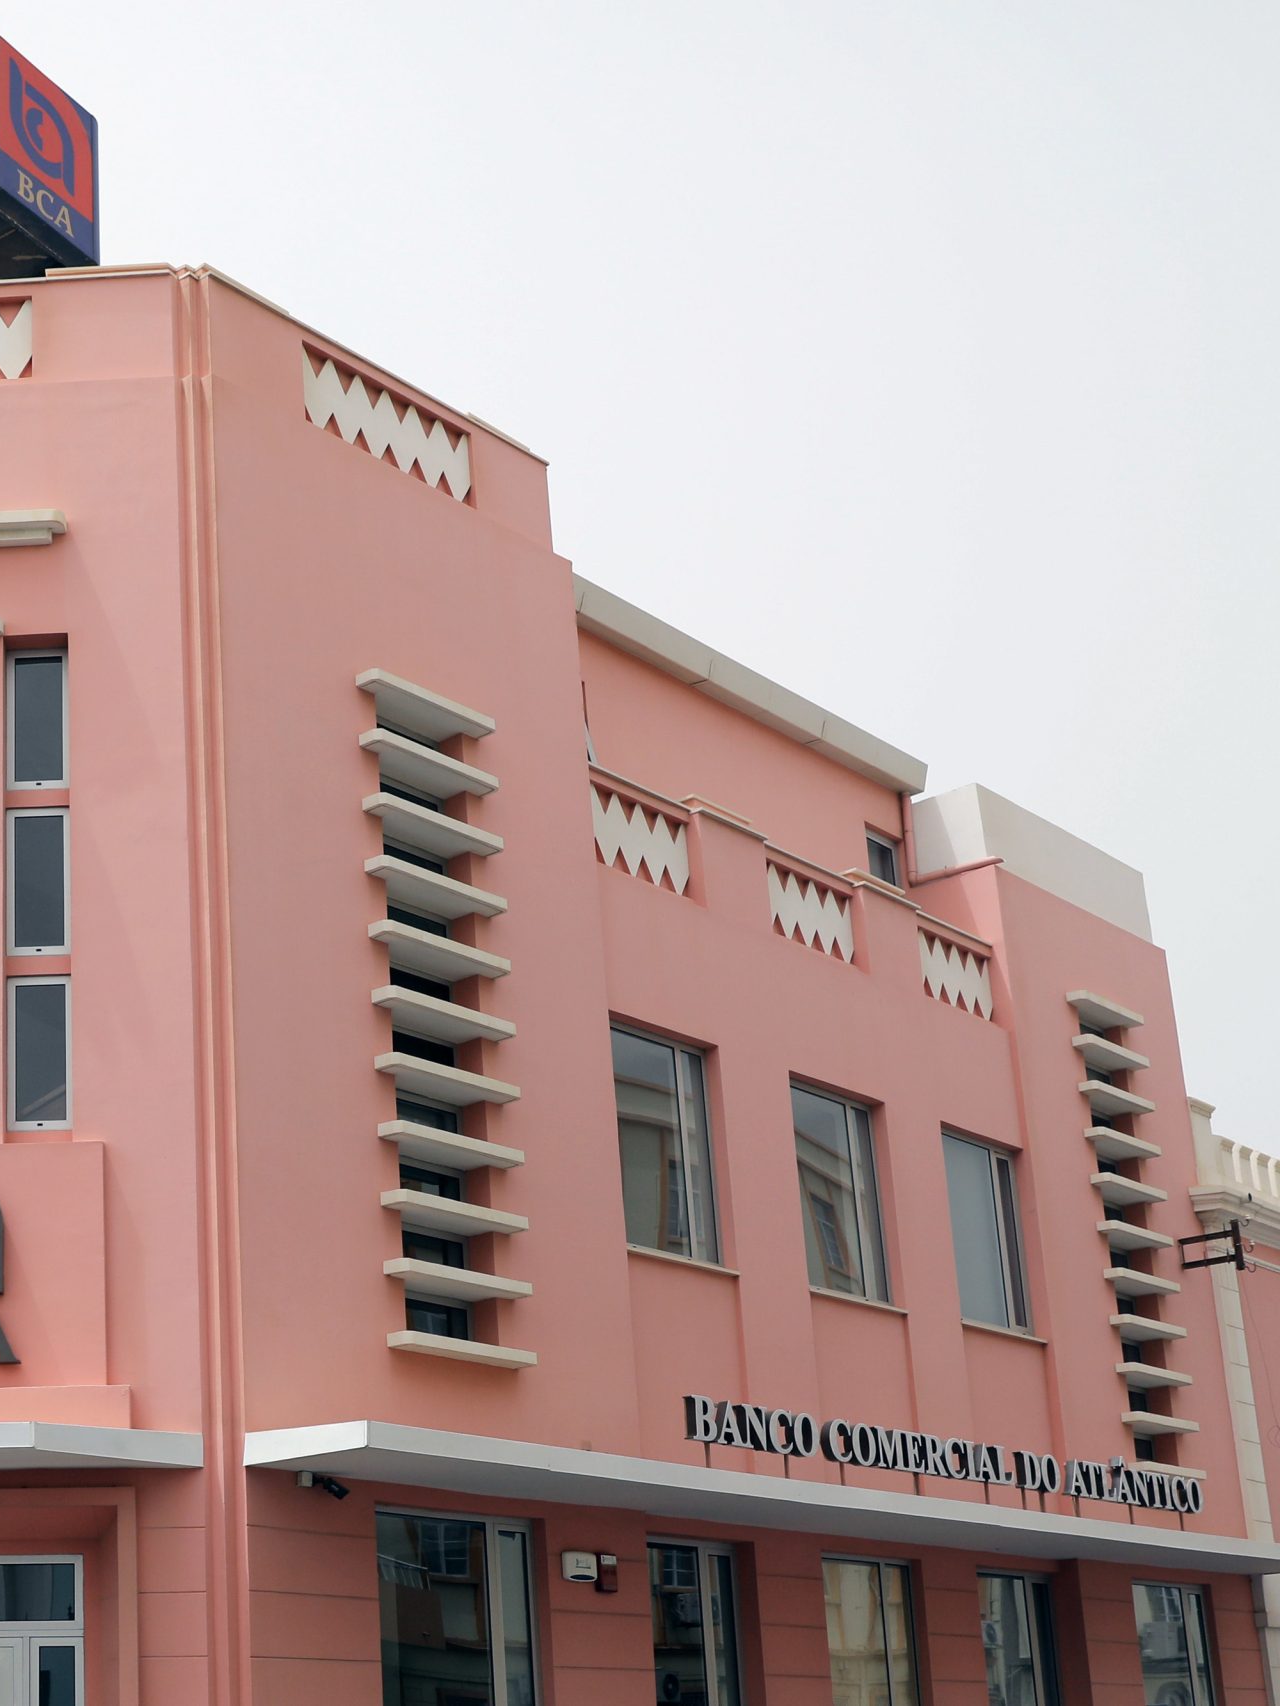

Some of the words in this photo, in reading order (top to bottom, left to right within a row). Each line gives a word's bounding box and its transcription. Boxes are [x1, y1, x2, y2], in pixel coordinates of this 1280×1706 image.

[17, 168, 74, 238] BCA
[683, 1394, 819, 1458] BANCO
[820, 1418, 1015, 1486] COMERCIAL
[1012, 1449, 1062, 1494] DO
[1063, 1455, 1205, 1514] ATLÂNTICO
